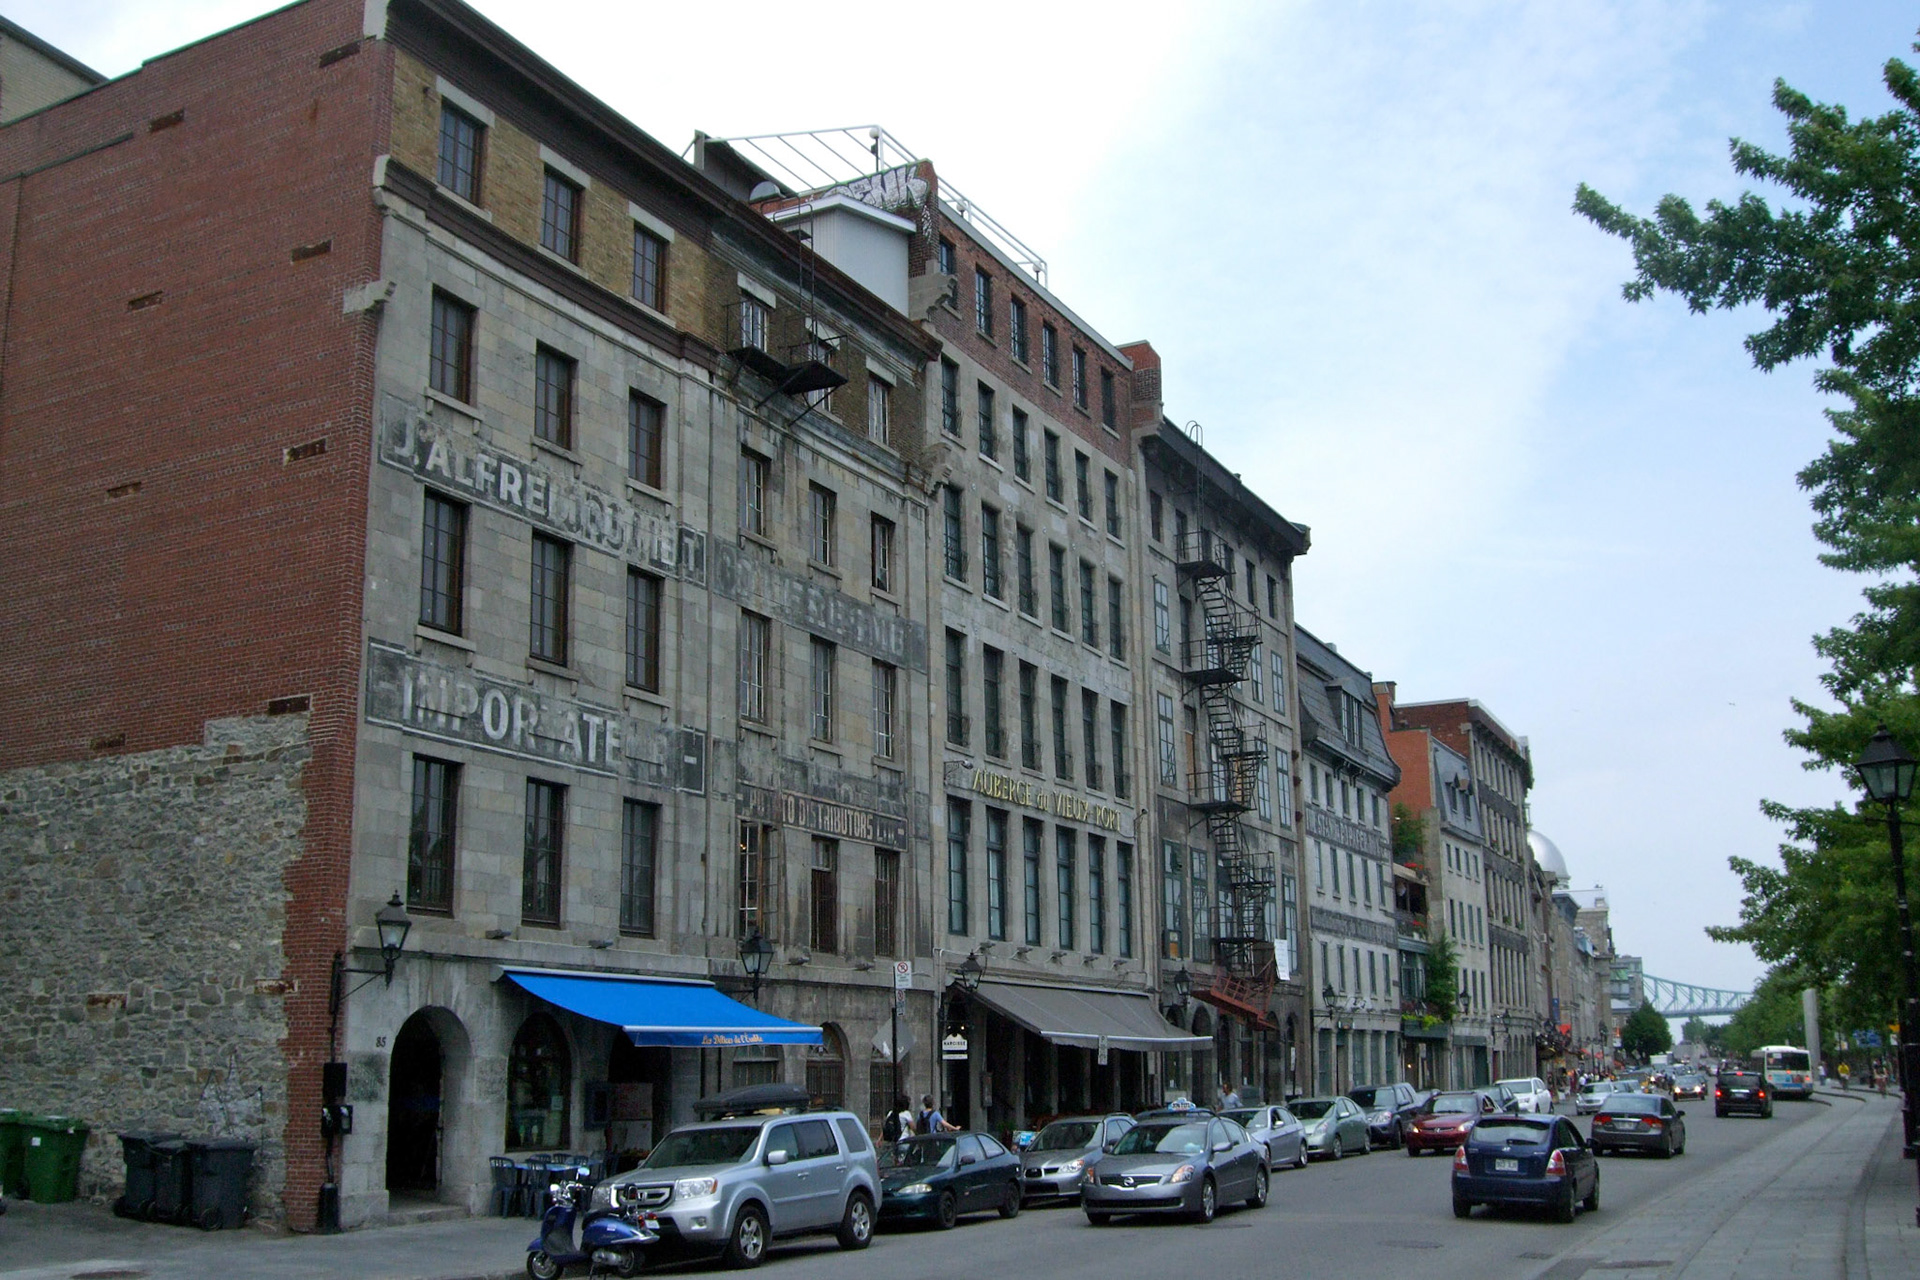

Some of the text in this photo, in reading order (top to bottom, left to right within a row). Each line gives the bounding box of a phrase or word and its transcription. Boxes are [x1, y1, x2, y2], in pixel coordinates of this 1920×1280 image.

[972, 767, 1032, 807] AUBERGE
[799, 798, 873, 841] DISTRIBUTORS
[376, 1036, 387, 1047] 85
